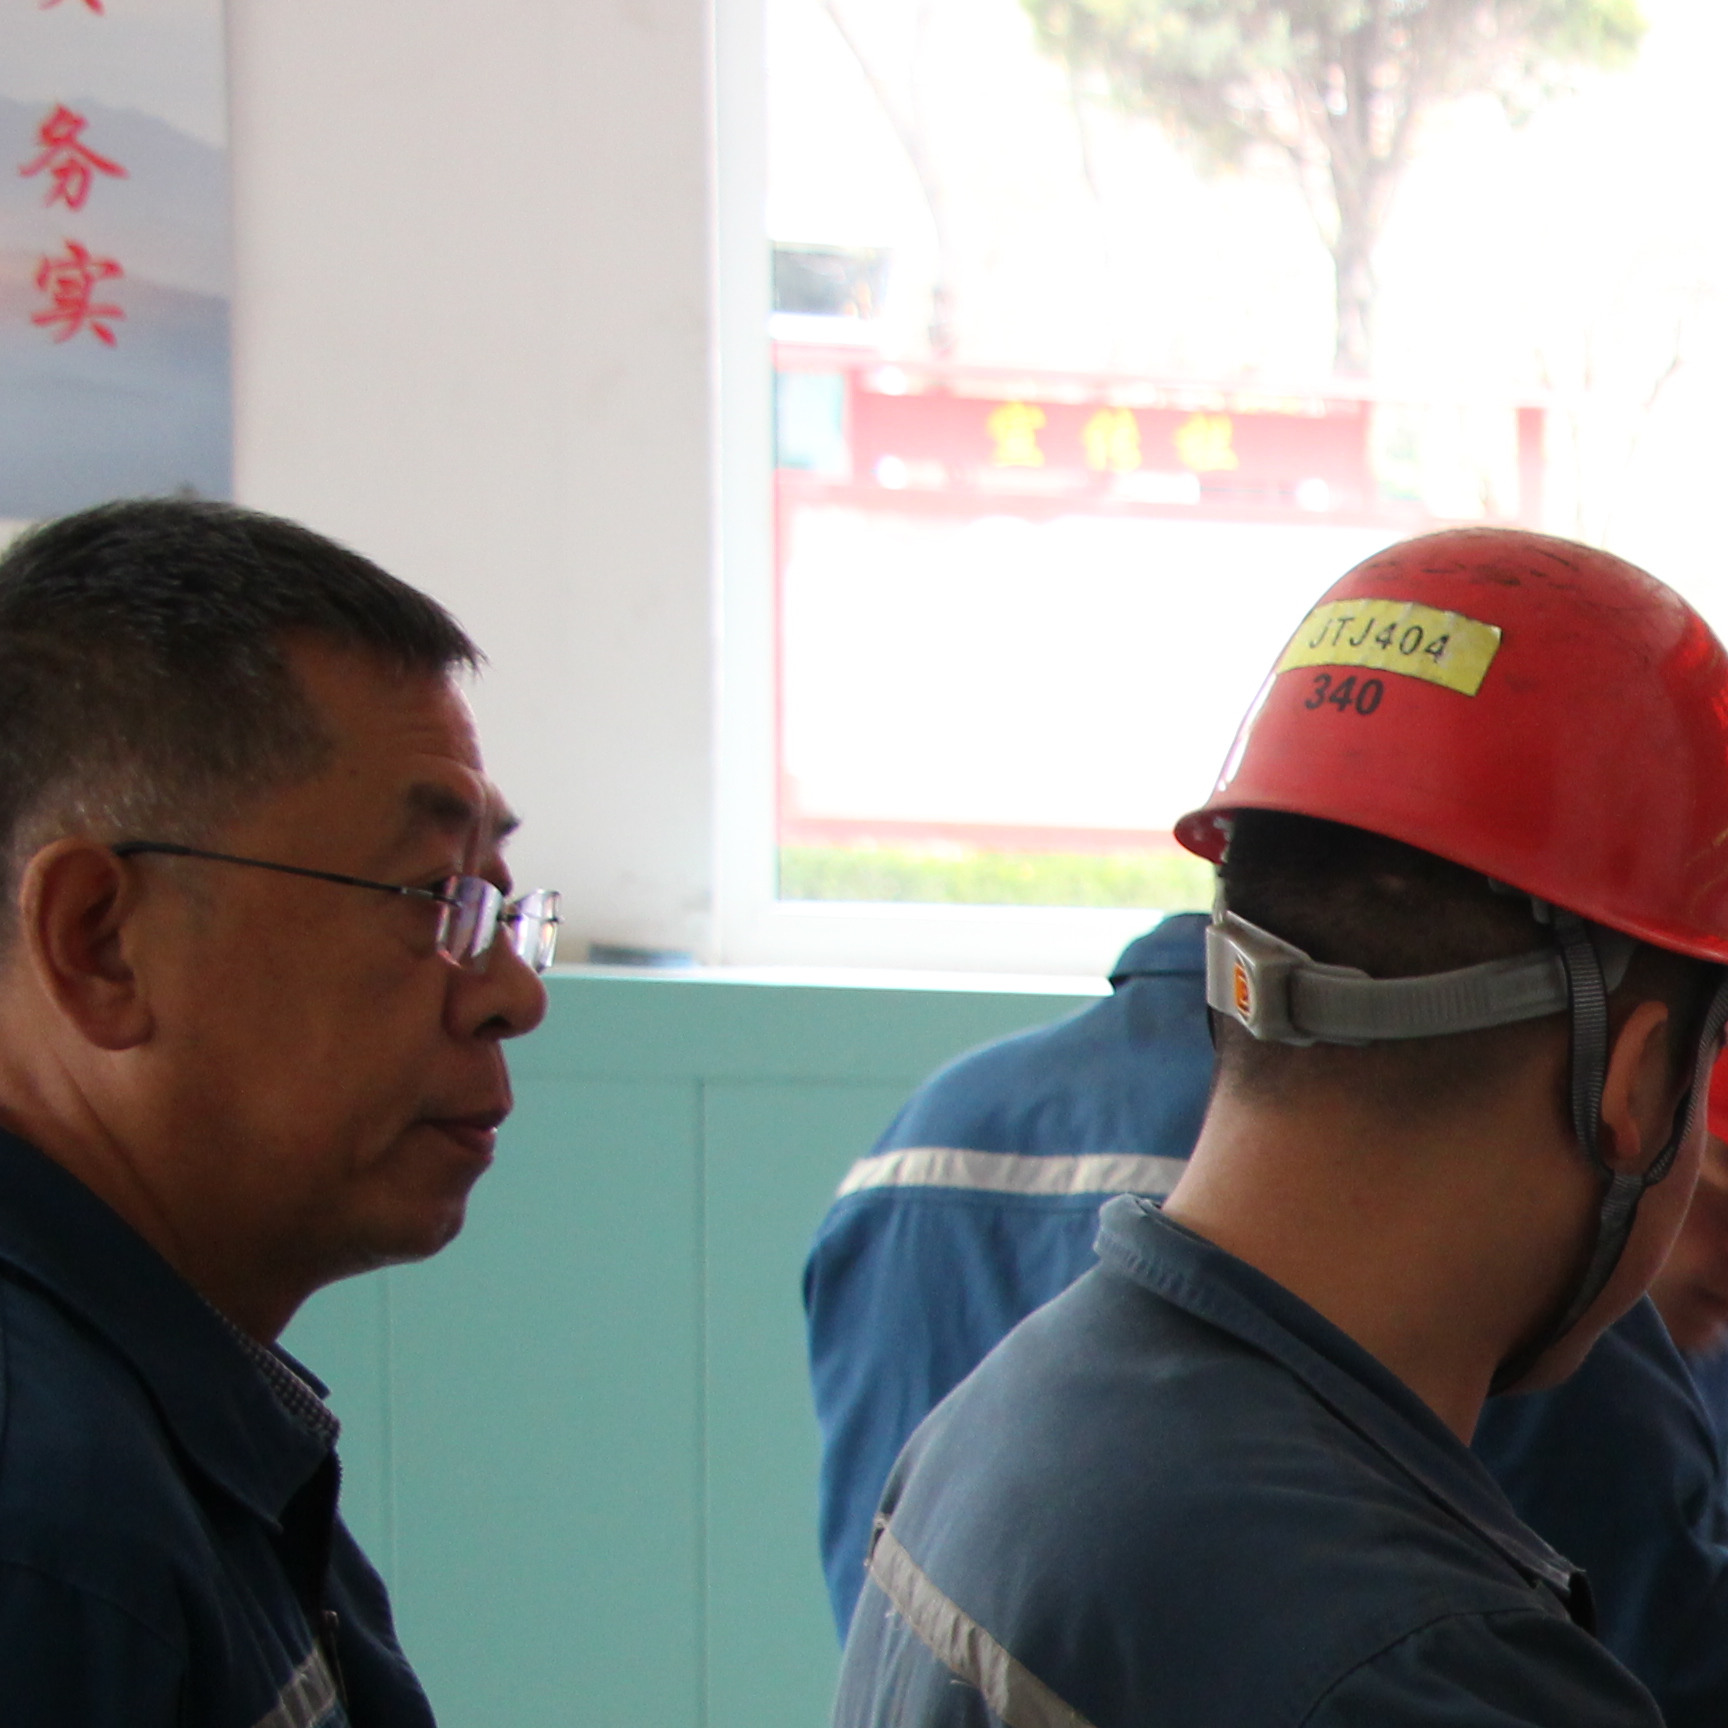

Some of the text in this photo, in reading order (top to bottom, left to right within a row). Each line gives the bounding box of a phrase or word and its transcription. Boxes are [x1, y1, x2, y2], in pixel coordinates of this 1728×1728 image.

[18, 0, 130, 347] 务实
[1308, 617, 1450, 663] JTJ404
[1304, 673, 1383, 715] 340
